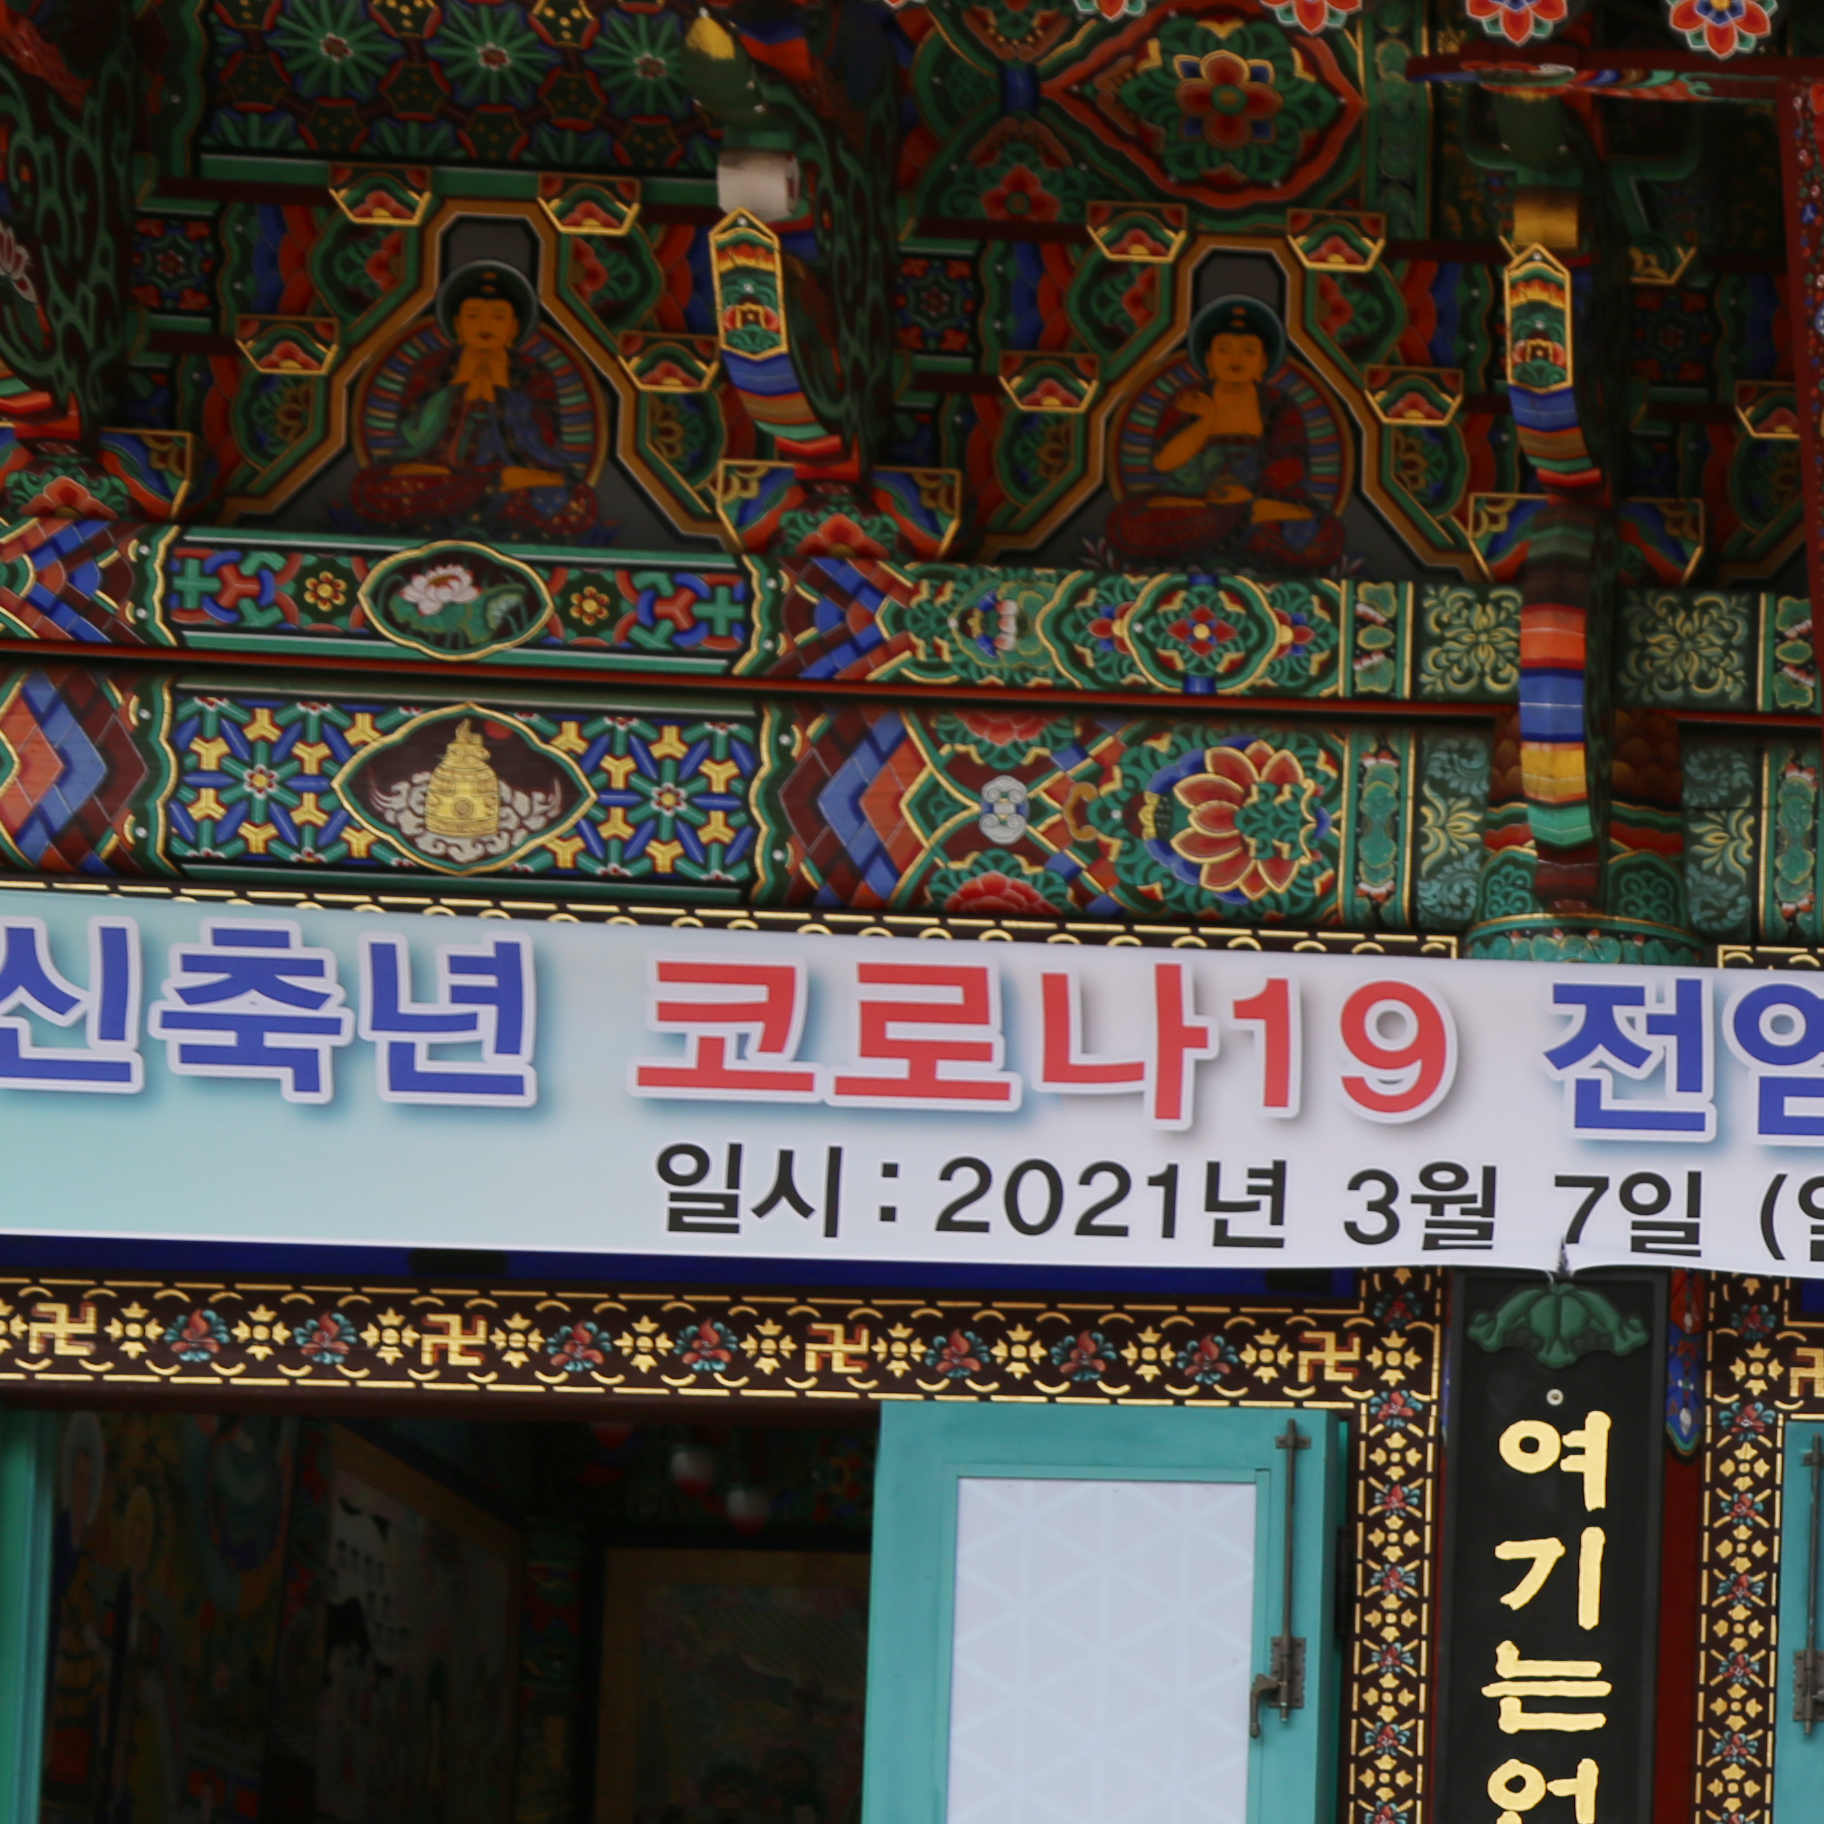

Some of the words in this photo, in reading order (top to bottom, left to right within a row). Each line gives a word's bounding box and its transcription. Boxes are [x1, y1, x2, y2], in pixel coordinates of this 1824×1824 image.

[0, 926, 525, 1096] 신축년
[637, 961, 1448, 1121] 코로나19
[1343, 1161, 1497, 1252] 3월
[1553, 1170, 1703, 1256] 7일
